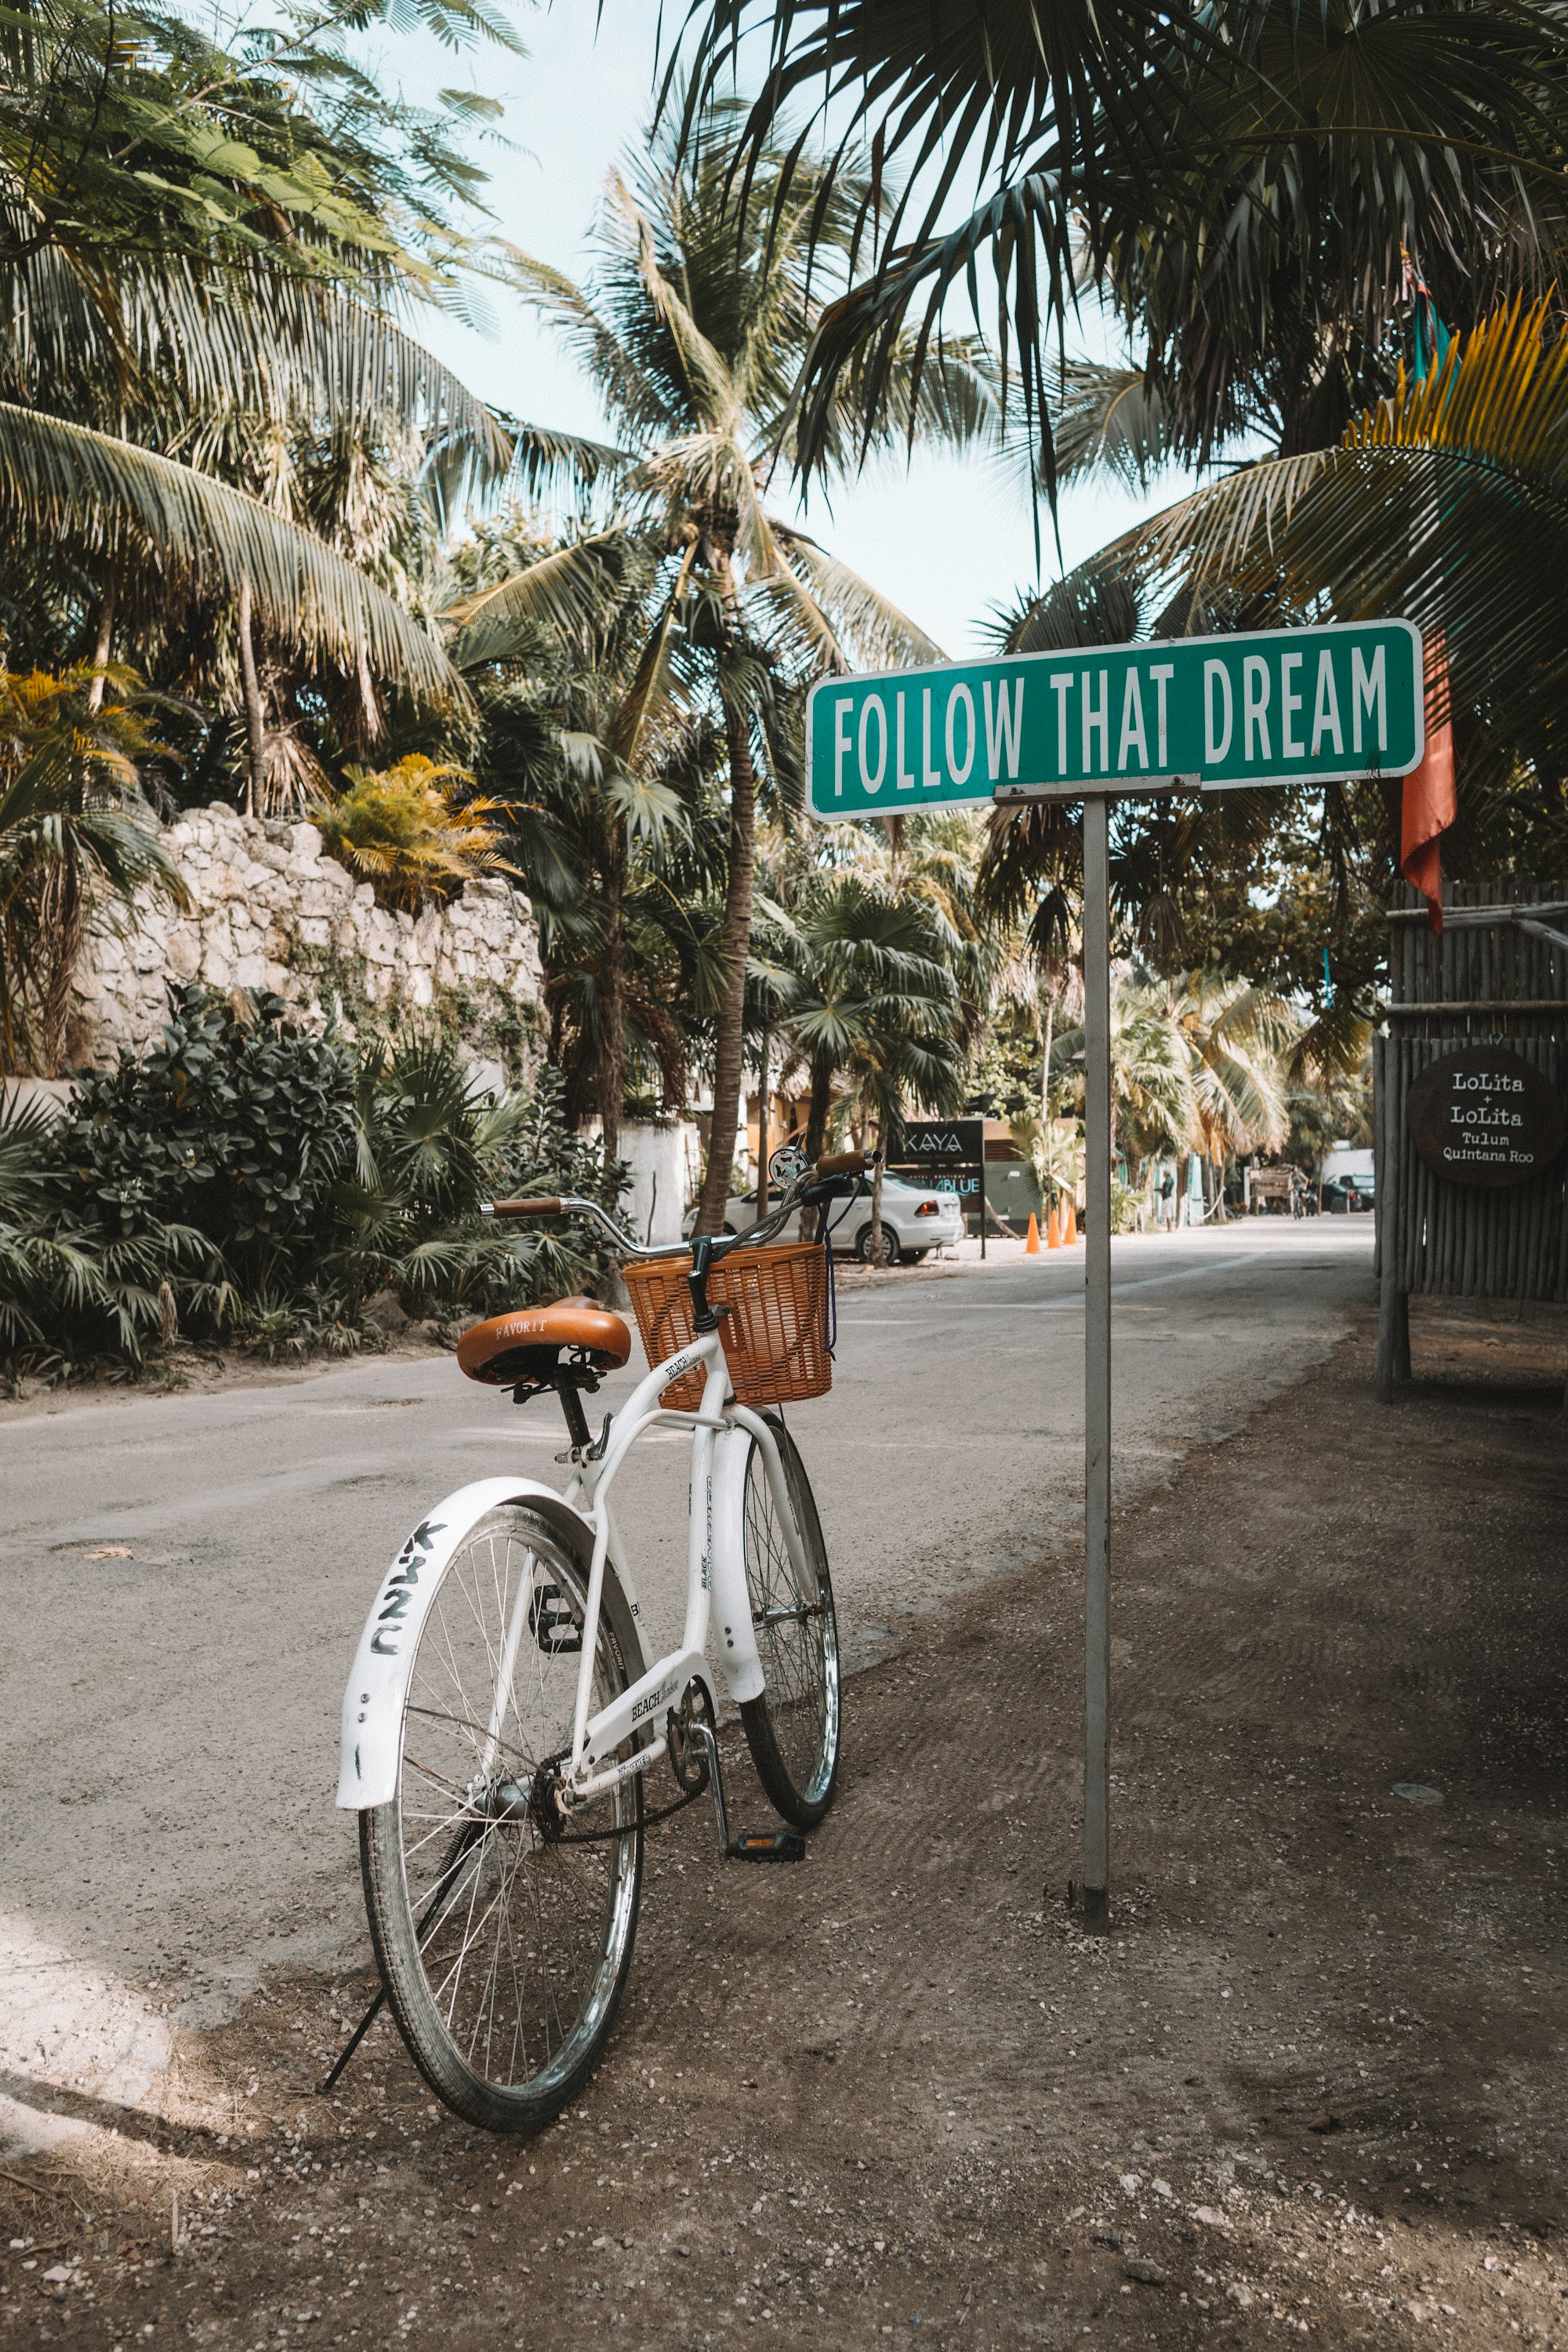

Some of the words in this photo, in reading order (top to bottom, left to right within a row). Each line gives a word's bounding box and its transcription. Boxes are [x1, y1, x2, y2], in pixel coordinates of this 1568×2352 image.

[834, 677, 1025, 797] FOLLOW
[1050, 664, 1174, 775] THAT
[1204, 645, 1388, 765] DREAM
[1453, 1073, 1524, 1092] LoLita
[1450, 1106, 1523, 1127] LoLita
[902, 1133, 963, 1152] KAYA
[1462, 1132, 1509, 1146] Tulum
[1443, 1147, 1506, 1161] Quintana
[1510, 1150, 1534, 1163] Roo
[495, 1319, 547, 1340] FAVORIT
[665, 1356, 687, 1380] BEACH
[608, 1632, 625, 1671] FAVORIT
[632, 1690, 660, 1722] BEACH
[619, 1754, 652, 1780] PANTHER
